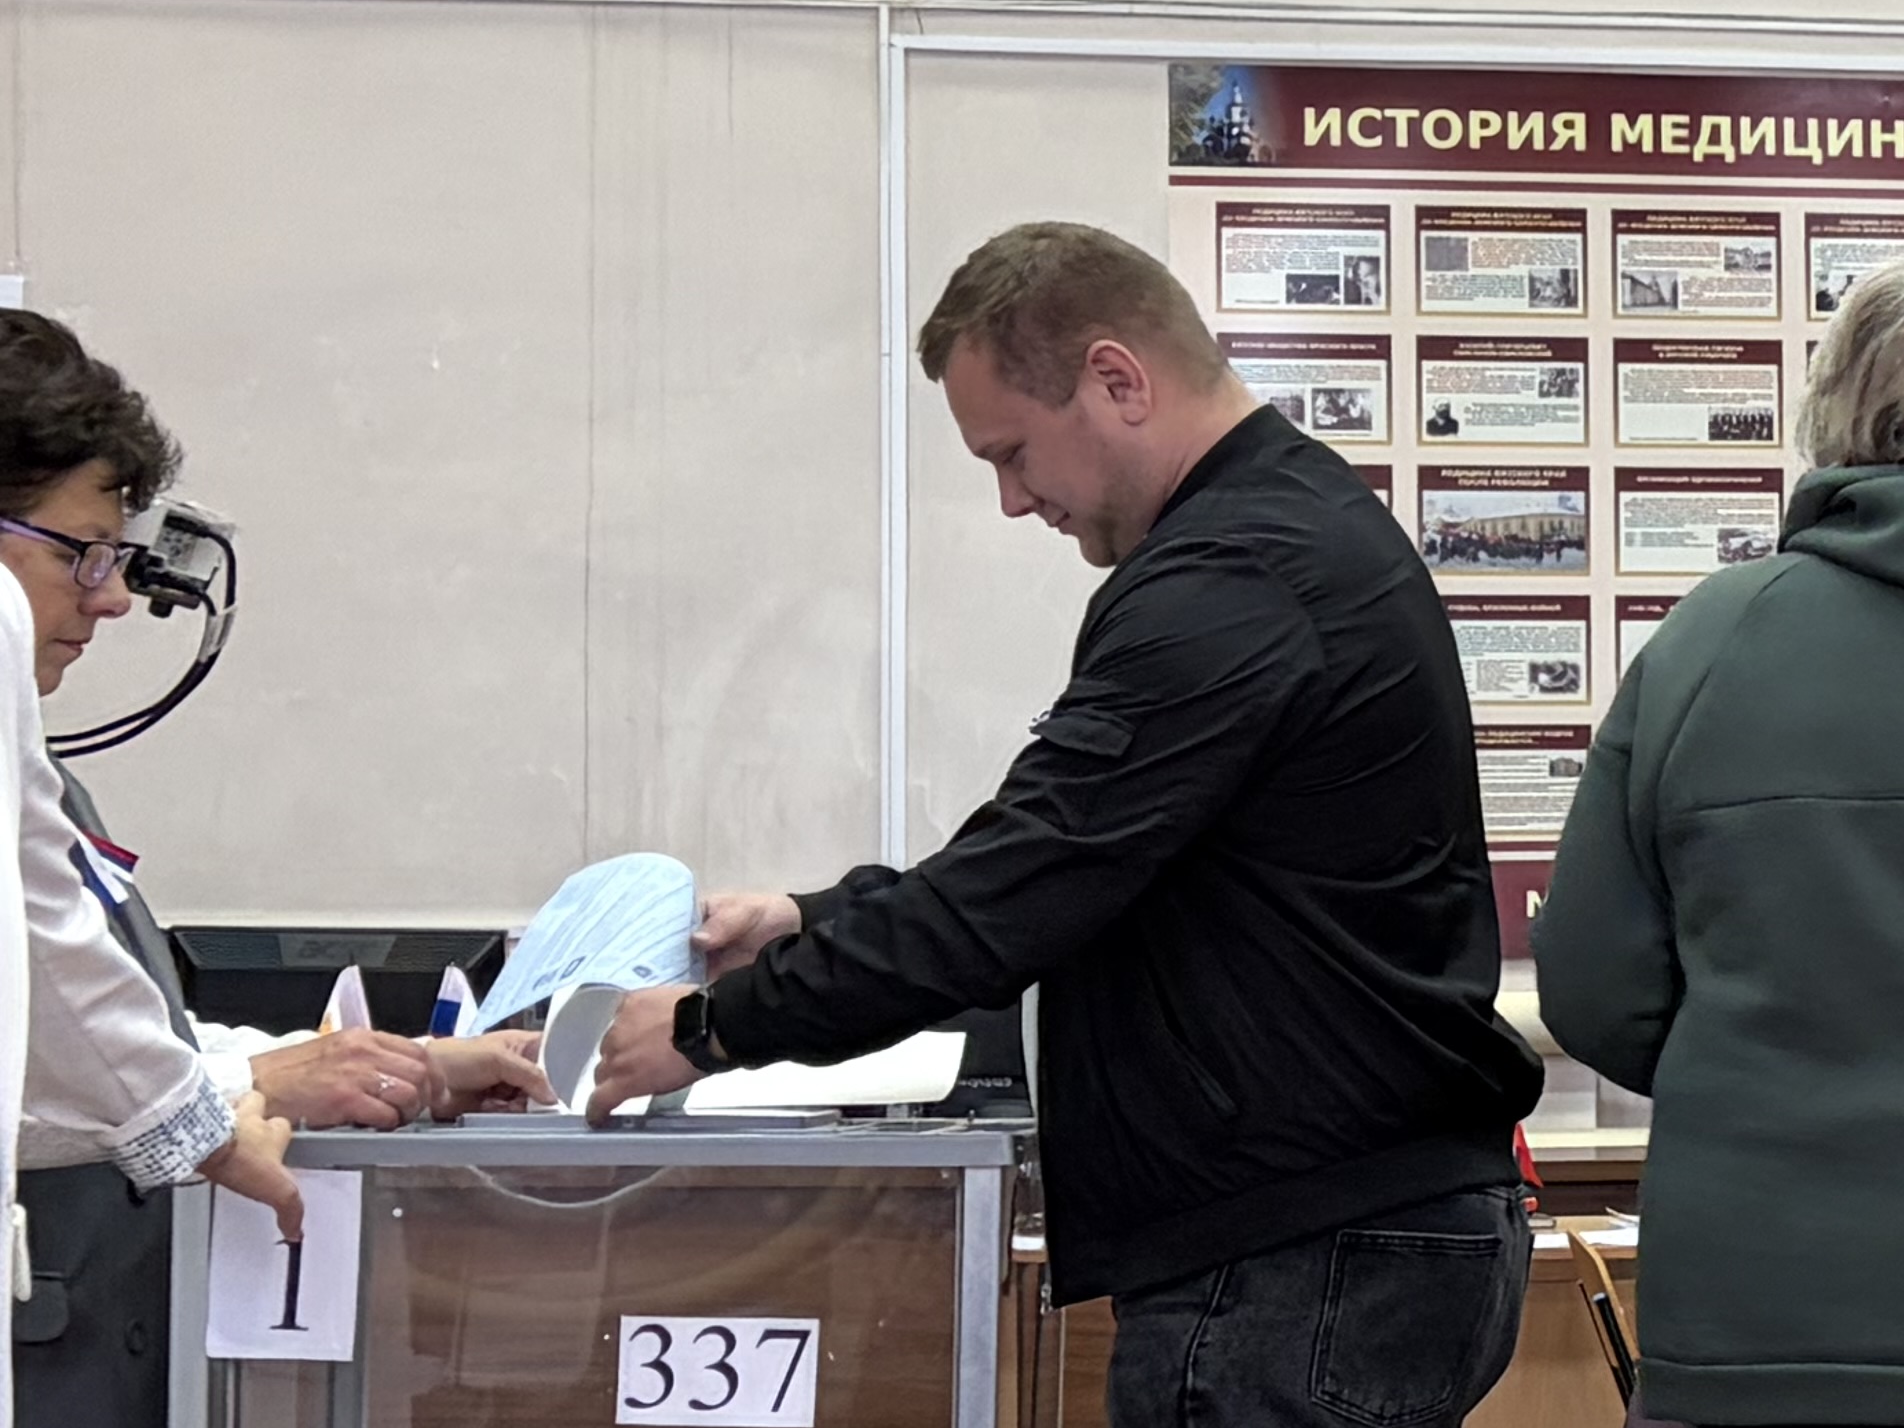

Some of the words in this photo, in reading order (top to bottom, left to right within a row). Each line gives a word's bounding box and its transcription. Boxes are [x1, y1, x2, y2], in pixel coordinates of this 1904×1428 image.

[1303, 106, 1587, 151] ИСТОРИЯ
[269, 1237, 310, 1332] 1
[623, 1323, 811, 1412] 337
